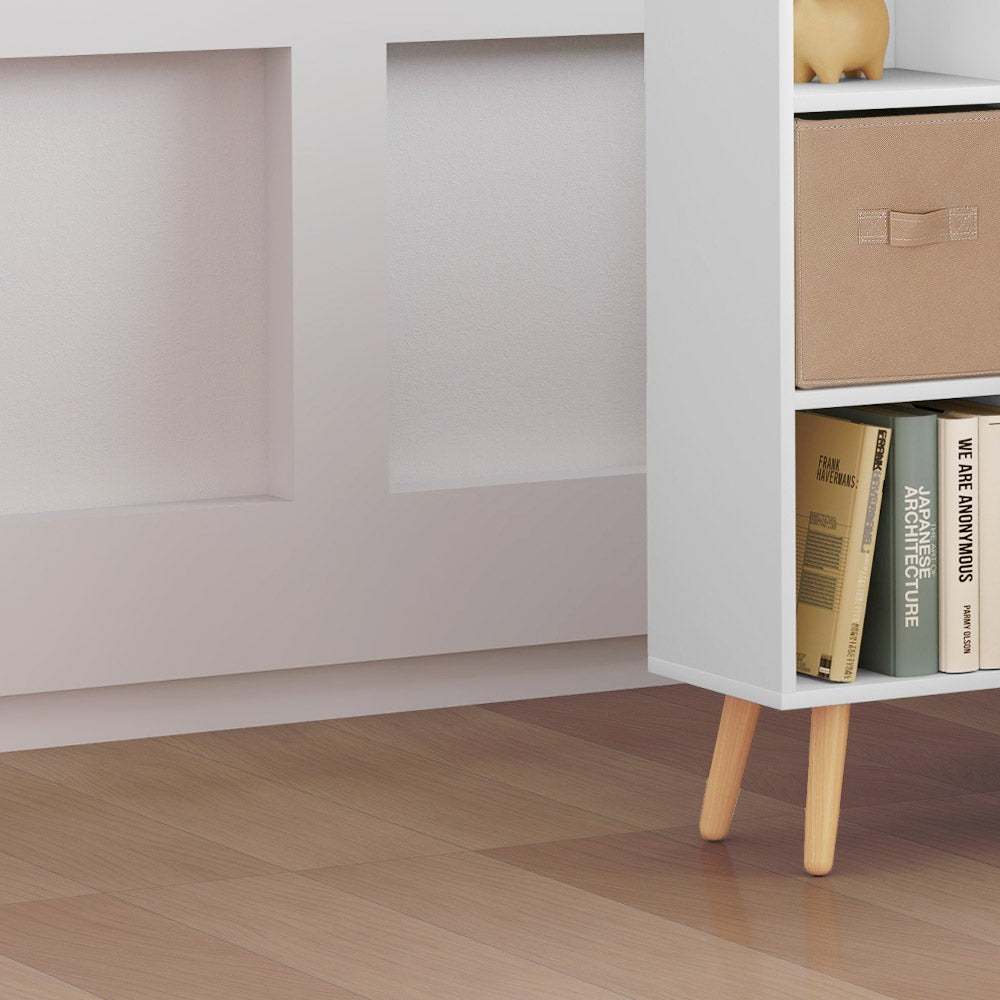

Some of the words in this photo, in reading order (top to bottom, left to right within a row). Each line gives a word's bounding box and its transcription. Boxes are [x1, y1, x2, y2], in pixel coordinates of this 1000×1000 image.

[958, 438, 972, 460] WE
[818, 455, 841, 472] FRANK
[958, 462, 972, 491] ARE
[918, 486, 931, 580] JAPANESE
[958, 494, 973, 583] ANONYMOUS
[904, 486, 919, 628] ARCHITECTURE
[962, 604, 970, 630] PARMY
[962, 632, 970, 654] OLSON
